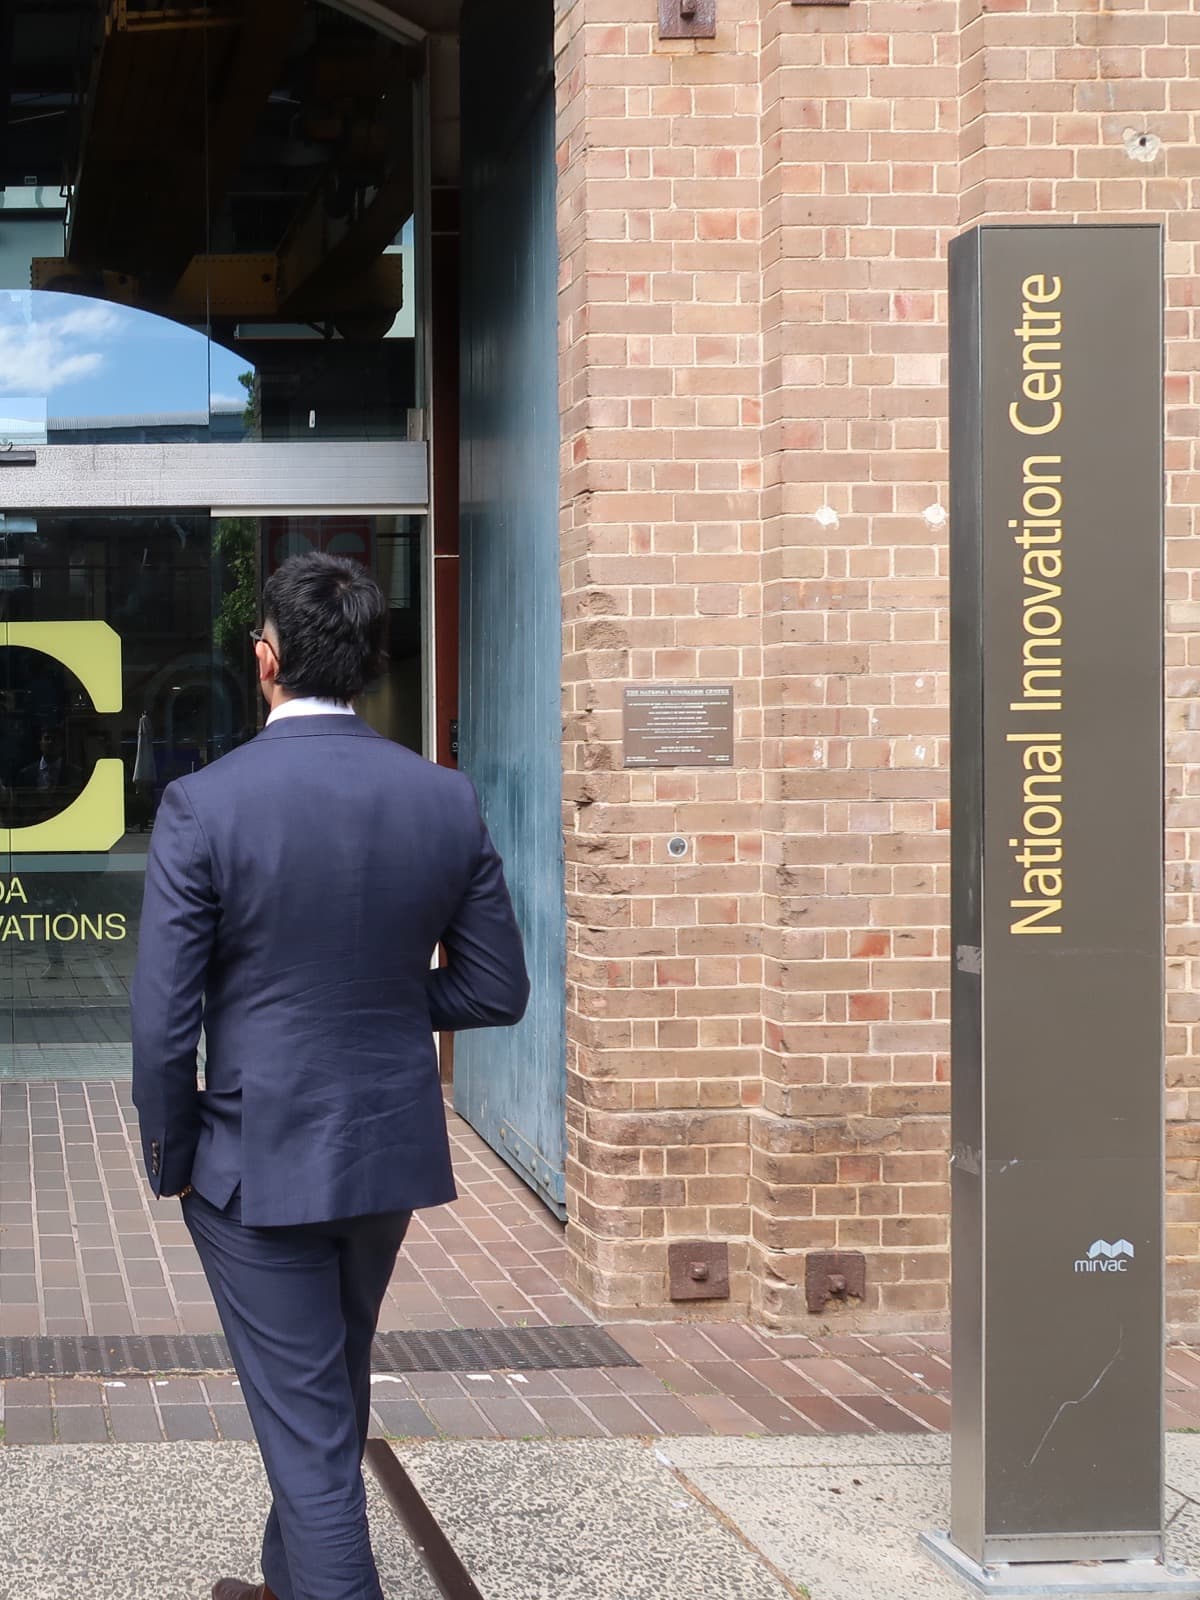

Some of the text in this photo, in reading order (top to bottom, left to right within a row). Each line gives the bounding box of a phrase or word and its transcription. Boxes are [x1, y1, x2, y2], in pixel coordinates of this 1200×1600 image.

[1007, 273, 1065, 935] National Innovation Centre
[1074, 1259, 1127, 1273] mirvac
